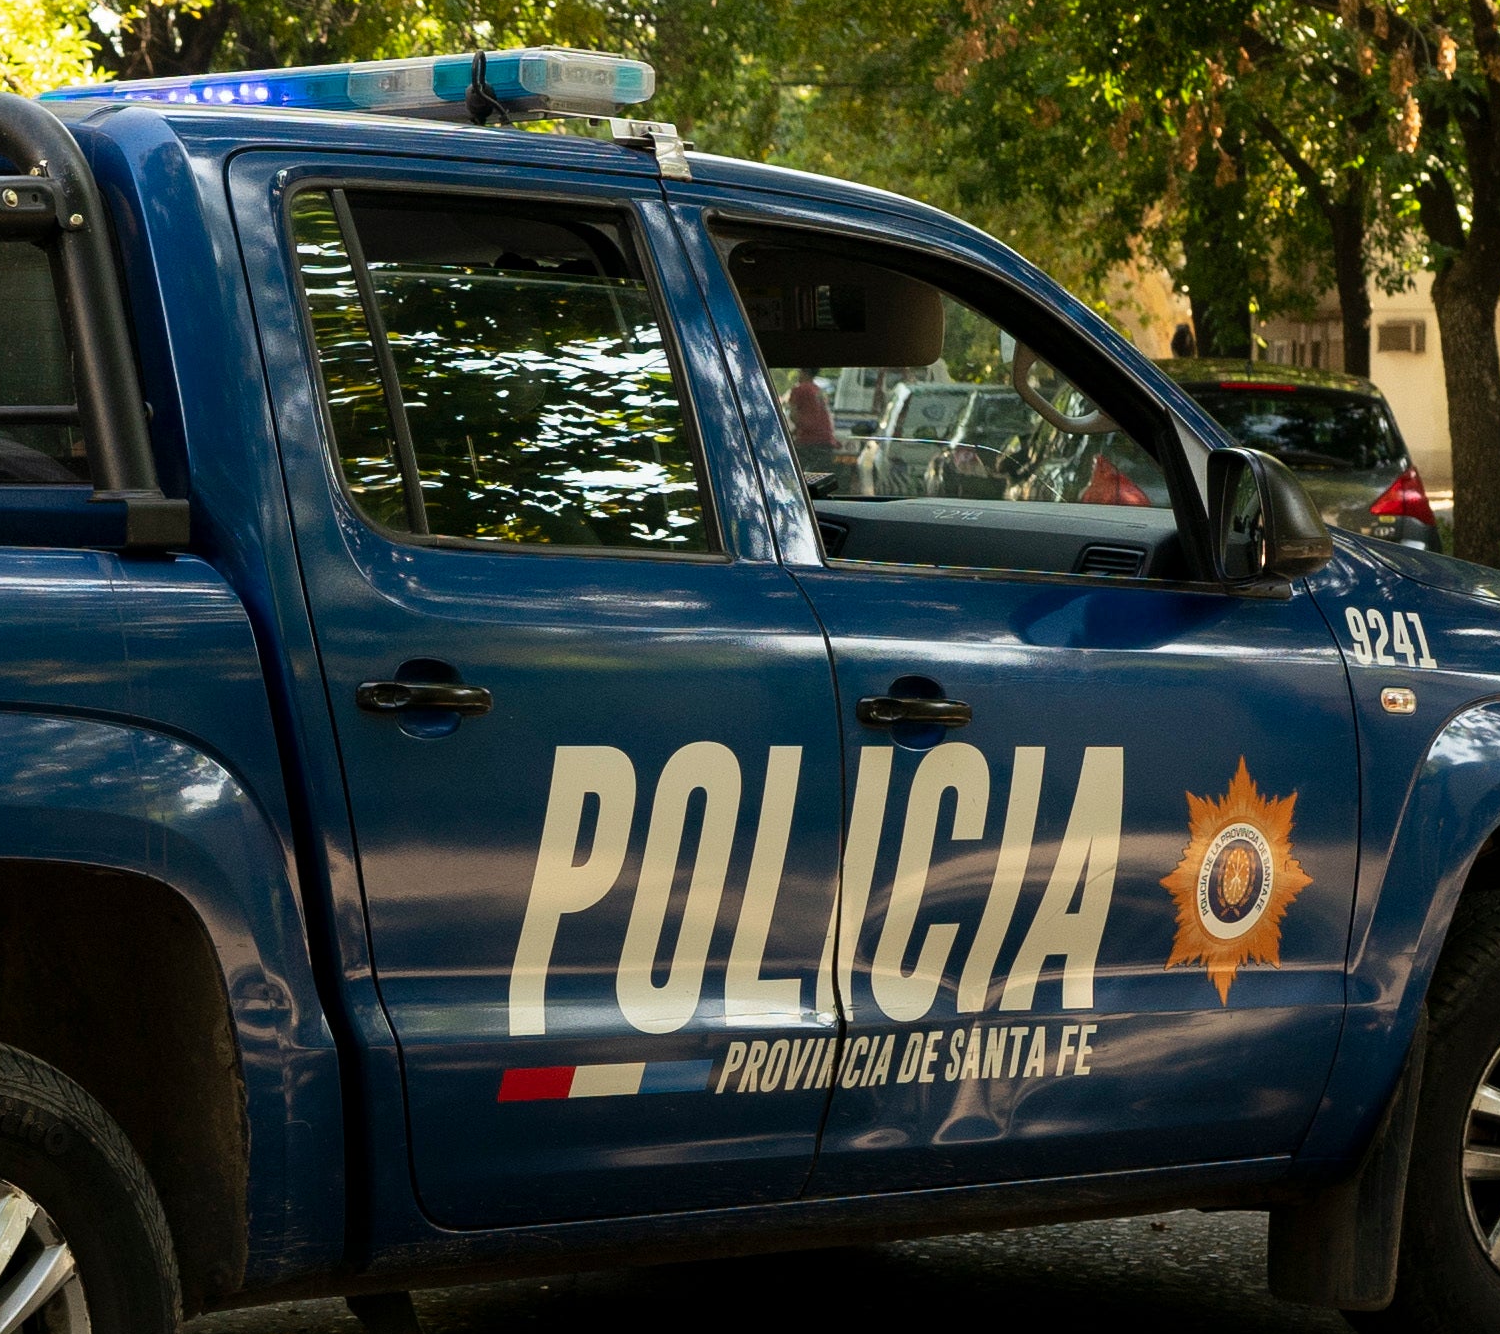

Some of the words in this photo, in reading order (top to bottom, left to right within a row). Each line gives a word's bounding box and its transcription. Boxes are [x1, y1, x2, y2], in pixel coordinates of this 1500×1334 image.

[1345, 607, 1437, 669] 9241
[508, 741, 1124, 1037] POLICIA
[715, 1034, 896, 1095] PROVINCIA
[896, 1030, 944, 1084] DE
[944, 1025, 1047, 1082] SANTA
[1056, 1024, 1098, 1076] FE
